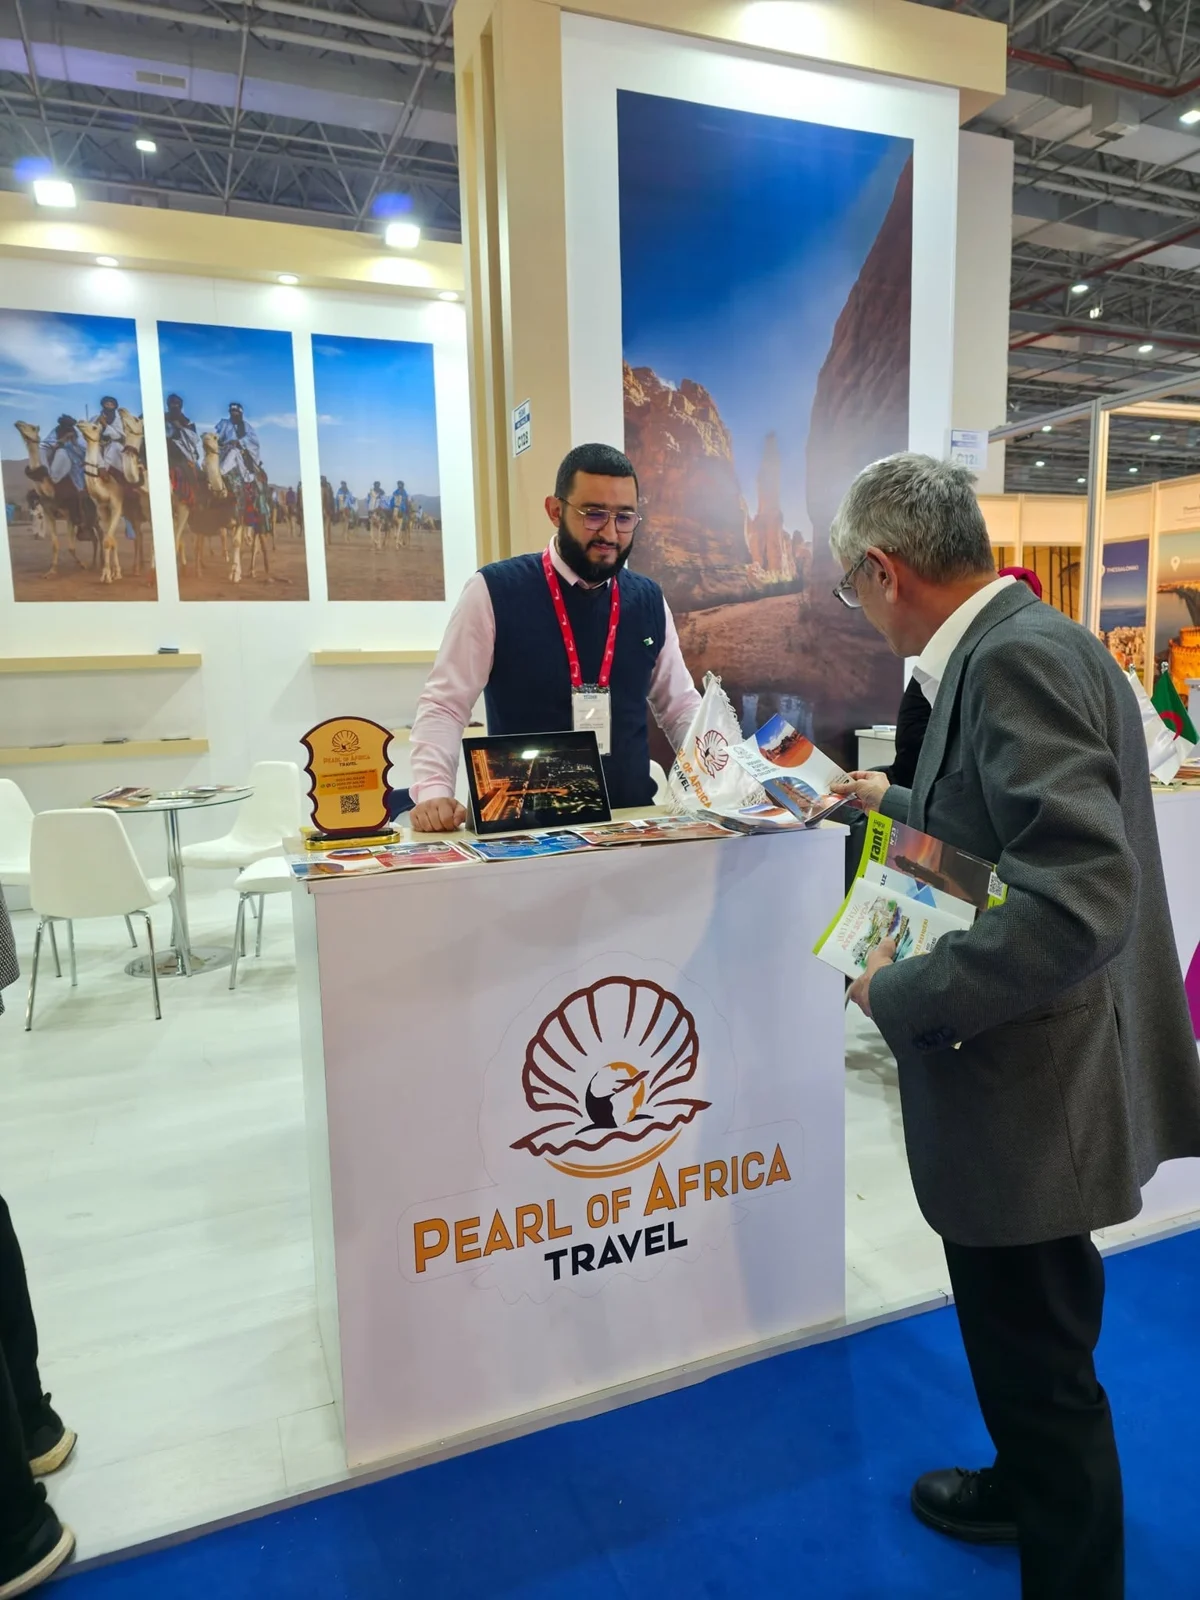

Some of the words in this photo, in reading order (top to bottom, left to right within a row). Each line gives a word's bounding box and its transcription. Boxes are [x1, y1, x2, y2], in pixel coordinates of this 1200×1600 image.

[682, 762, 693, 773] OF
[689, 775, 712, 808] AFRICA
[869, 827, 884, 862] rant
[880, 873, 888, 887] uz
[413, 1199, 573, 1274] PEARL
[586, 1187, 632, 1229] OF
[643, 1142, 792, 1216] AFRICA
[544, 1222, 688, 1281] TRAVEL
